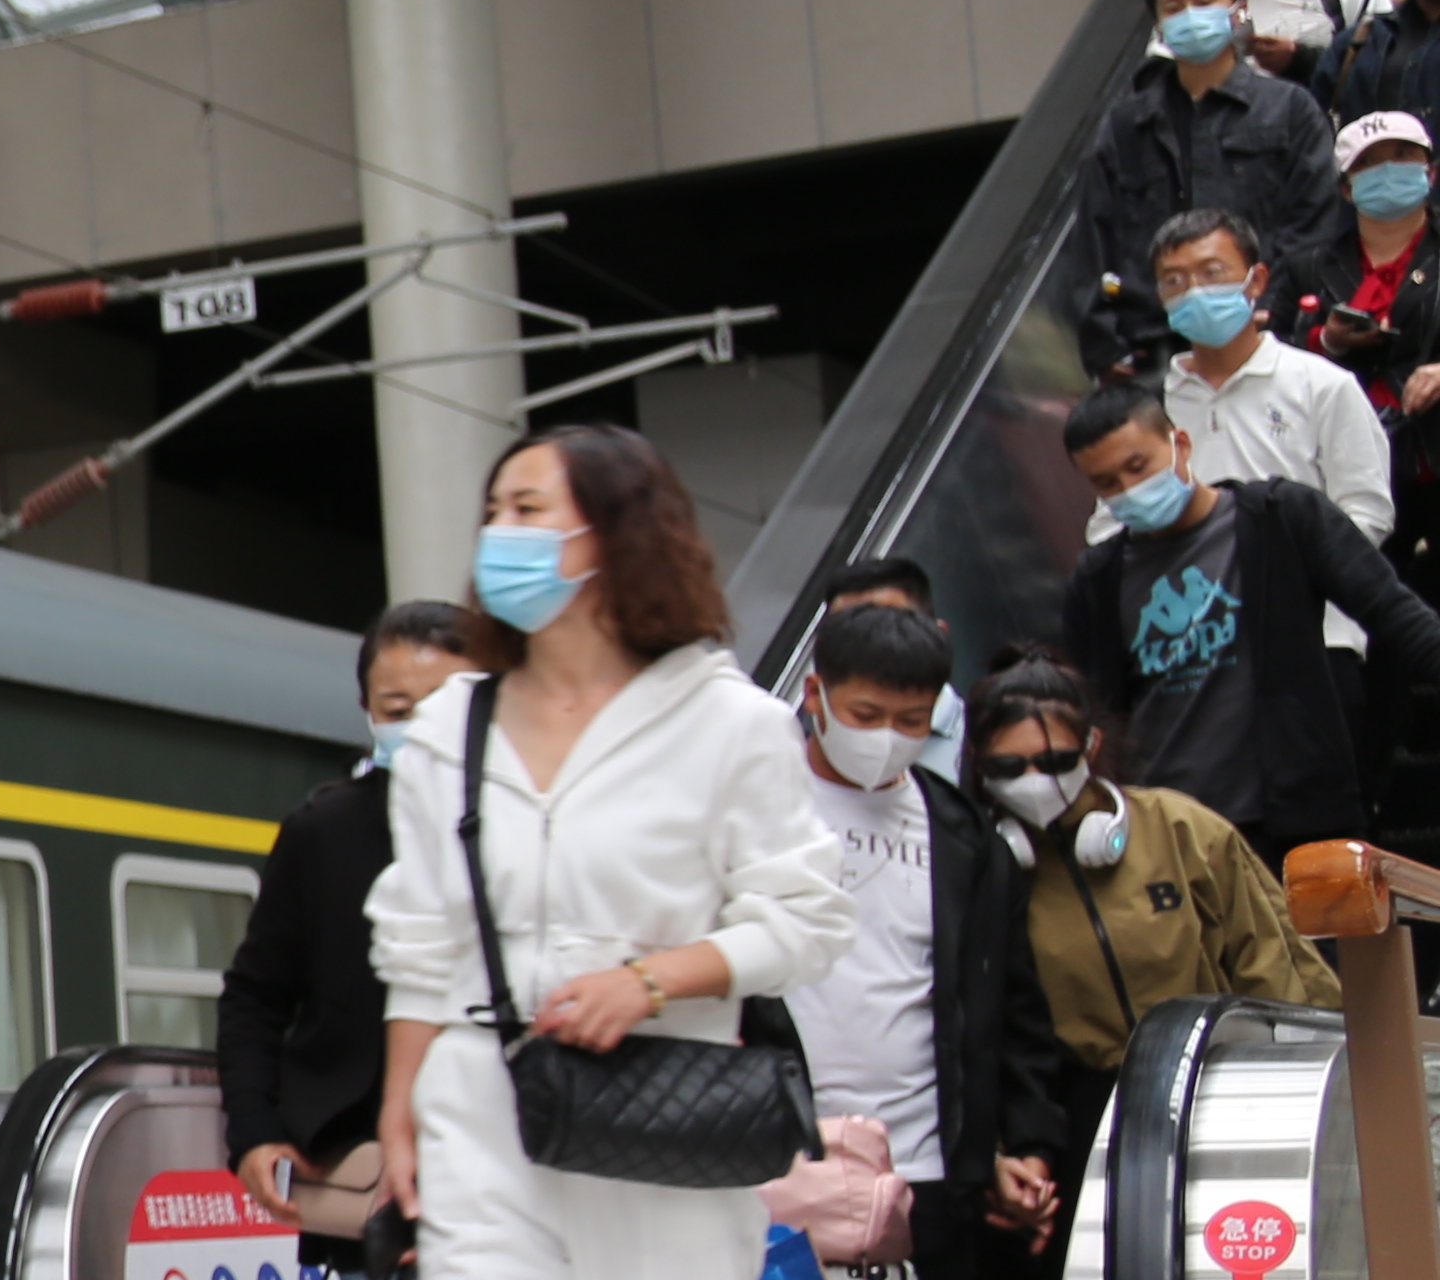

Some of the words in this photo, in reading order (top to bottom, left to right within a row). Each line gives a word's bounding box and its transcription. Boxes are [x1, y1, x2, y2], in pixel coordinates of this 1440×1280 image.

[1138, 612, 1236, 676] Kappa
[1145, 882, 1182, 914] B
[1218, 1217, 1282, 1242] 急停
[1221, 1245, 1276, 1260] STOP
